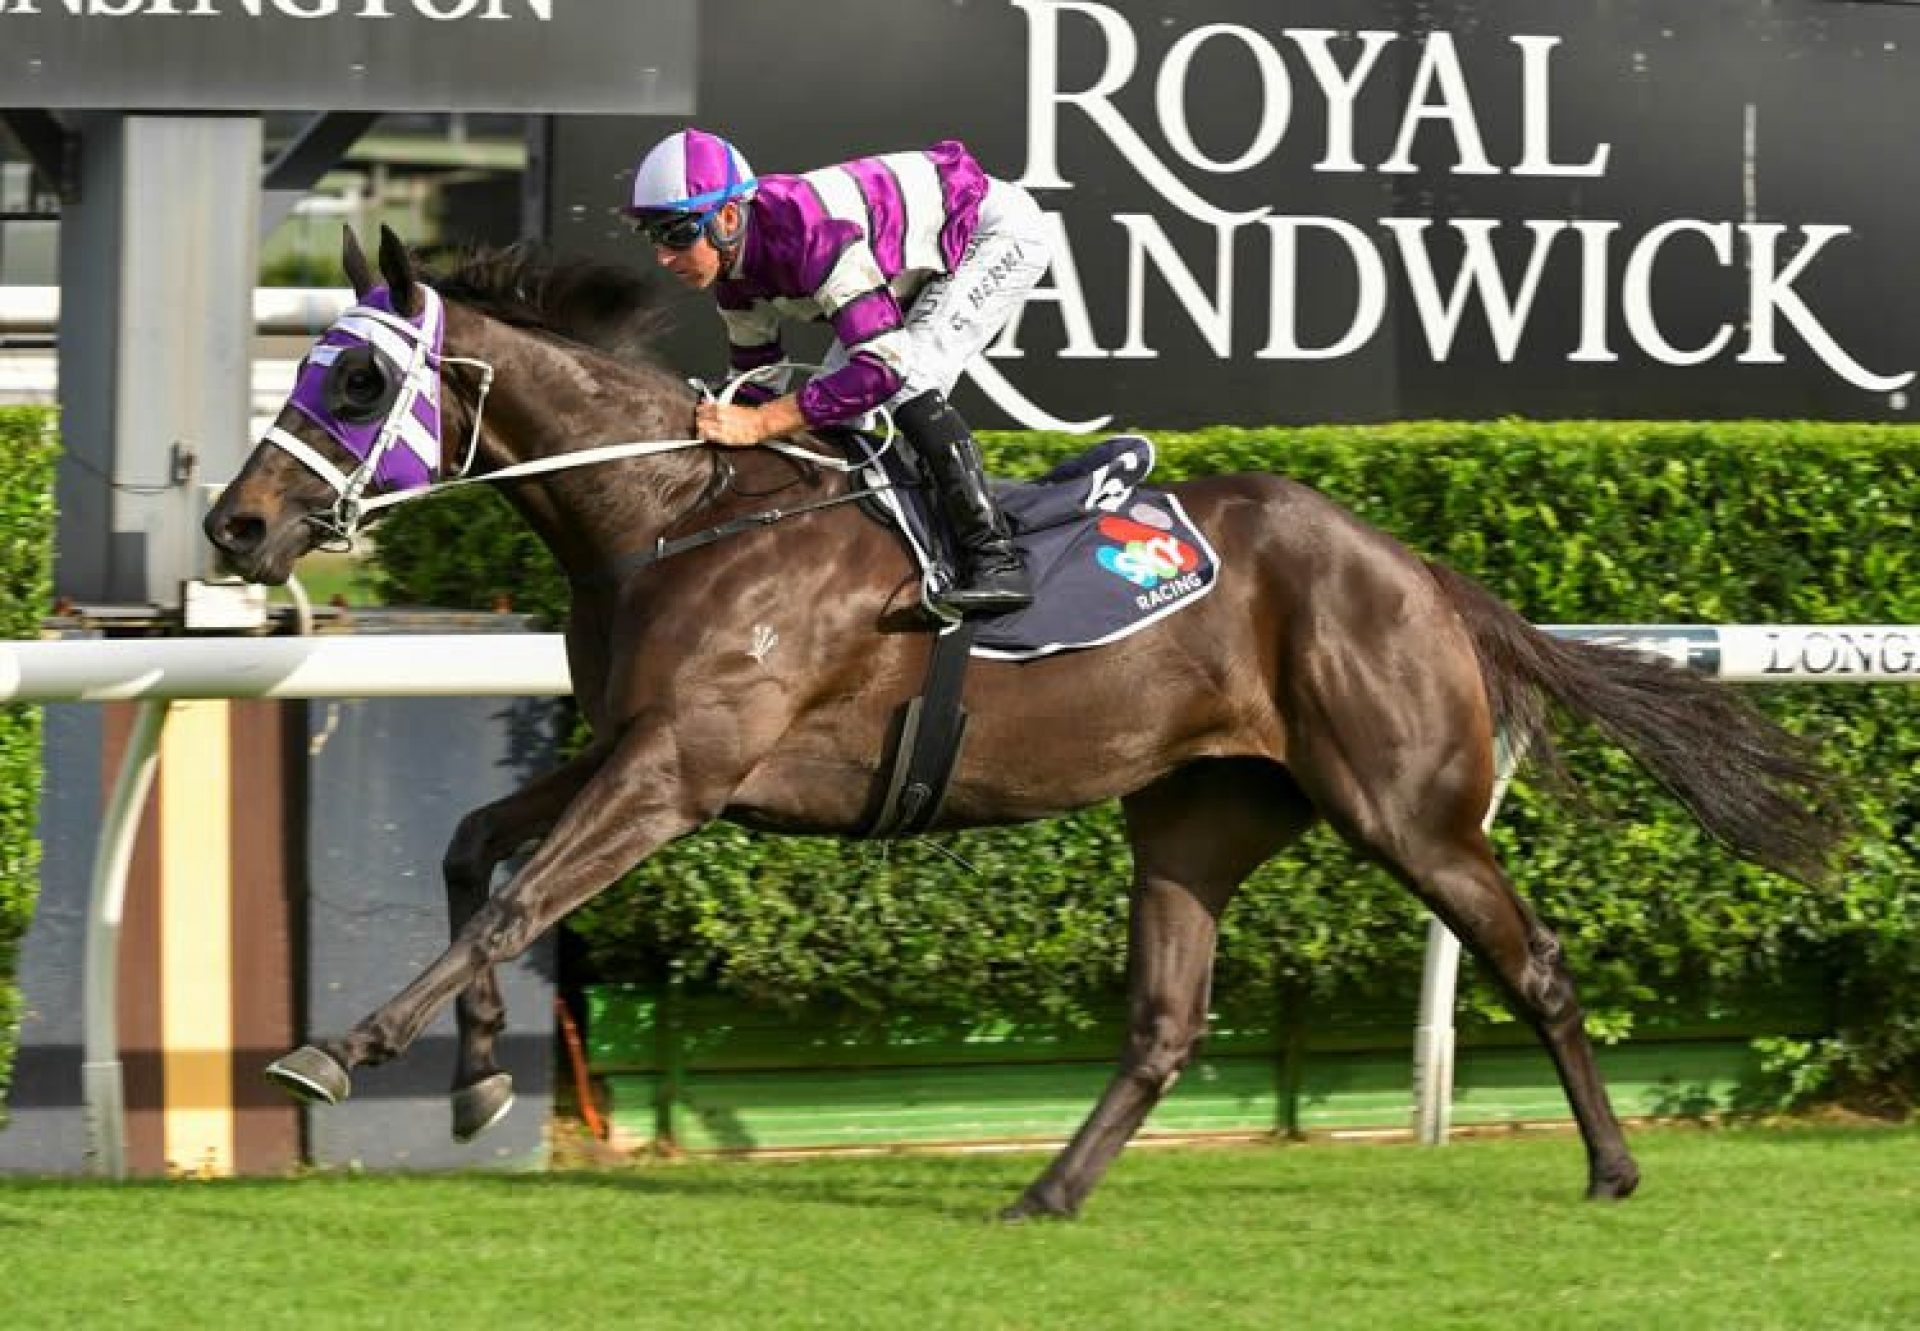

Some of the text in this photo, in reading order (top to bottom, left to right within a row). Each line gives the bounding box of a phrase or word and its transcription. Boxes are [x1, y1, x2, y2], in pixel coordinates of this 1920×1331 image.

[1013, 0, 1611, 224] ROYAL
[1135, 571, 1202, 610] RACING
[1761, 631, 1920, 674] LONG
